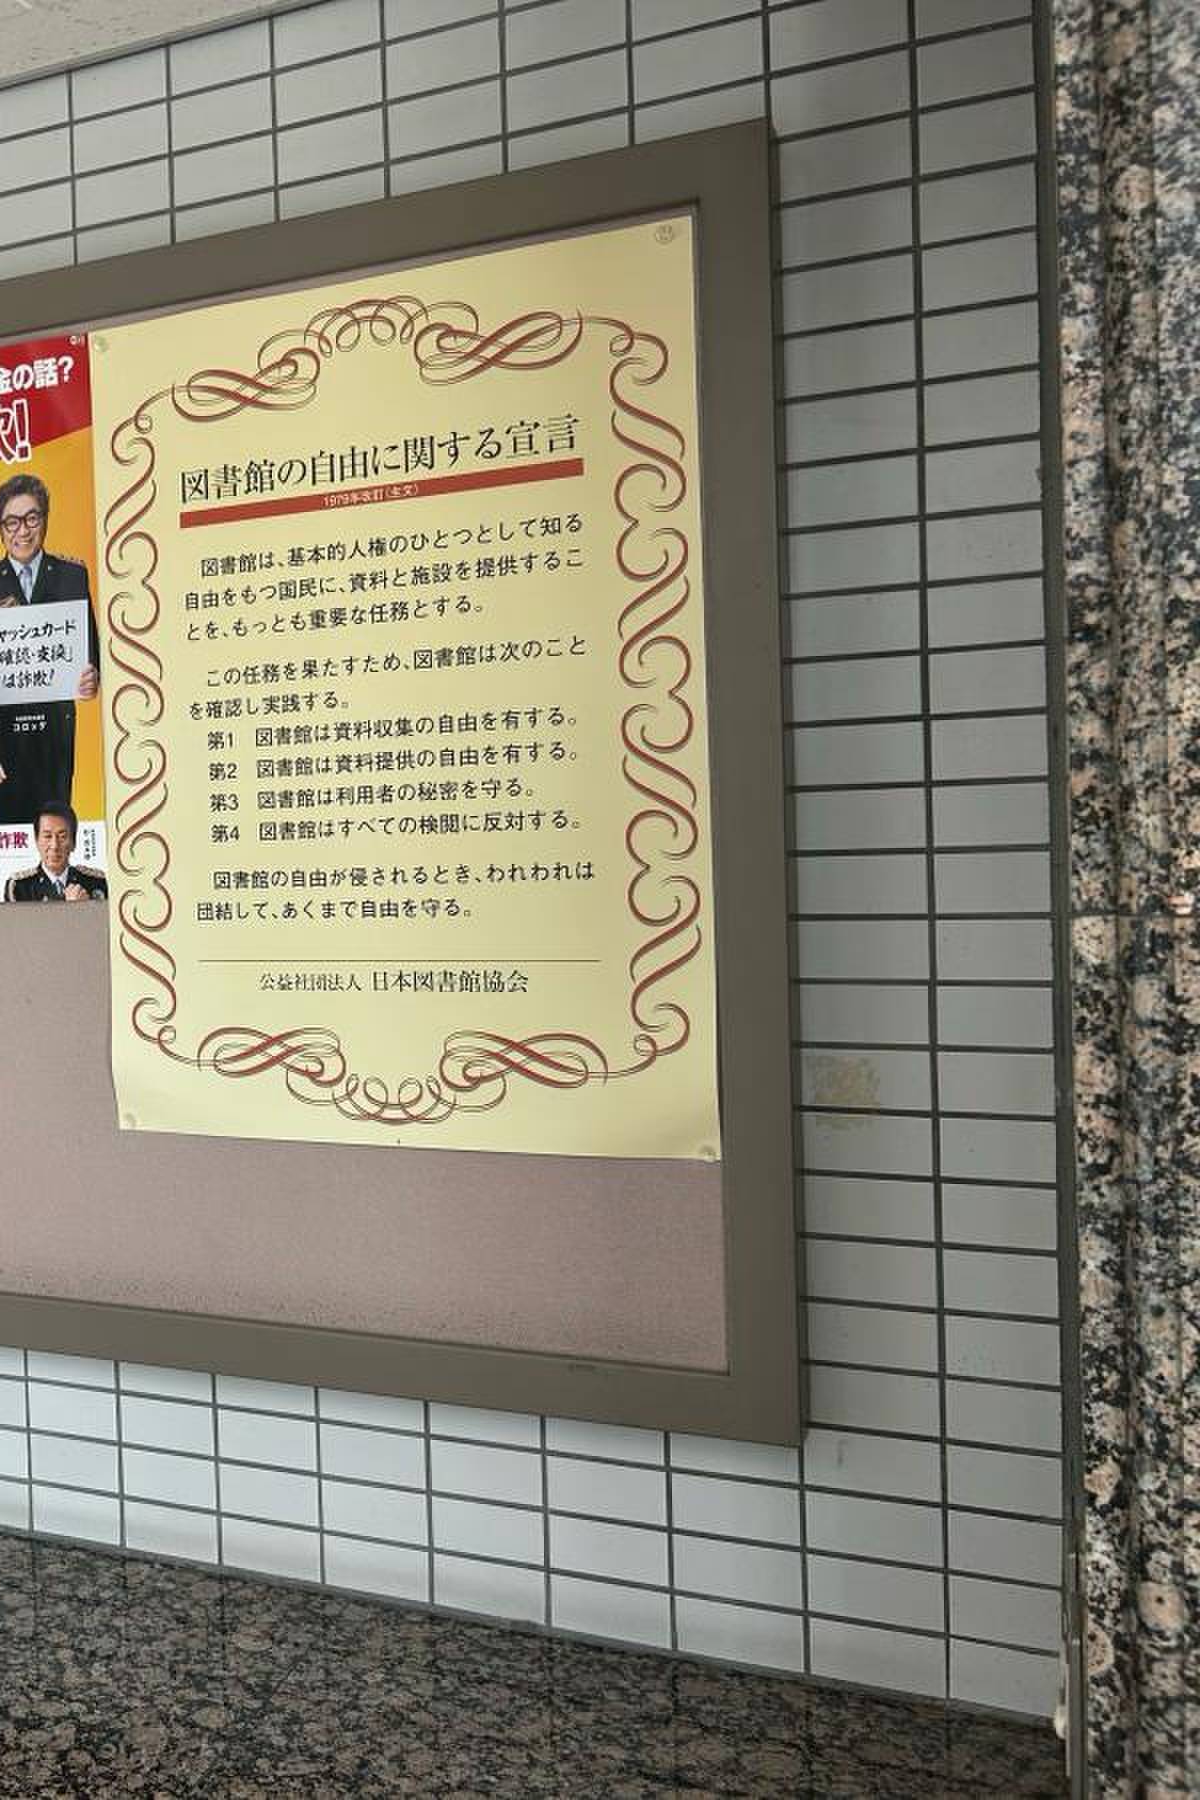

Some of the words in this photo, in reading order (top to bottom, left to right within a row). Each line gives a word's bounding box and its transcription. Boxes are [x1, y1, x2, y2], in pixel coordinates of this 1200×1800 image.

[180, 414, 581, 504] 図書館の自由に関する宣言
[201, 512, 583, 577] 図書館は、基本的人権のひとつとして知る
[184, 546, 583, 611] 自由をもつ国民に、資料と施設を提供するこ
[186, 593, 483, 643] とを、もっとも重要な任務とする。
[207, 634, 585, 688] この任務を果たすため、図書館は次のこと
[189, 688, 349, 721] を確認し実践する。
[207, 729, 236, 750] 第1
[255, 705, 576, 747] 図書館は資料収集の自由を有する。
[208, 760, 237, 781] 第2
[256, 740, 577, 779] 図書館は資料提供の自由を有する。
[209, 791, 238, 812] 第3
[257, 776, 532, 810] 図書館は利用者の秘密を守る。
[210, 823, 239, 843] 第4
[258, 808, 579, 841] 図書館はすべての検閲に反対する。
[213, 861, 593, 891] 図書館の自由が侵されるとき、われわれは
[196, 897, 470, 921] 団結して、あくまで自由を守る。
[259, 973, 361, 992] 公益社団法人
[372, 970, 528, 993] 日本図書館協会
